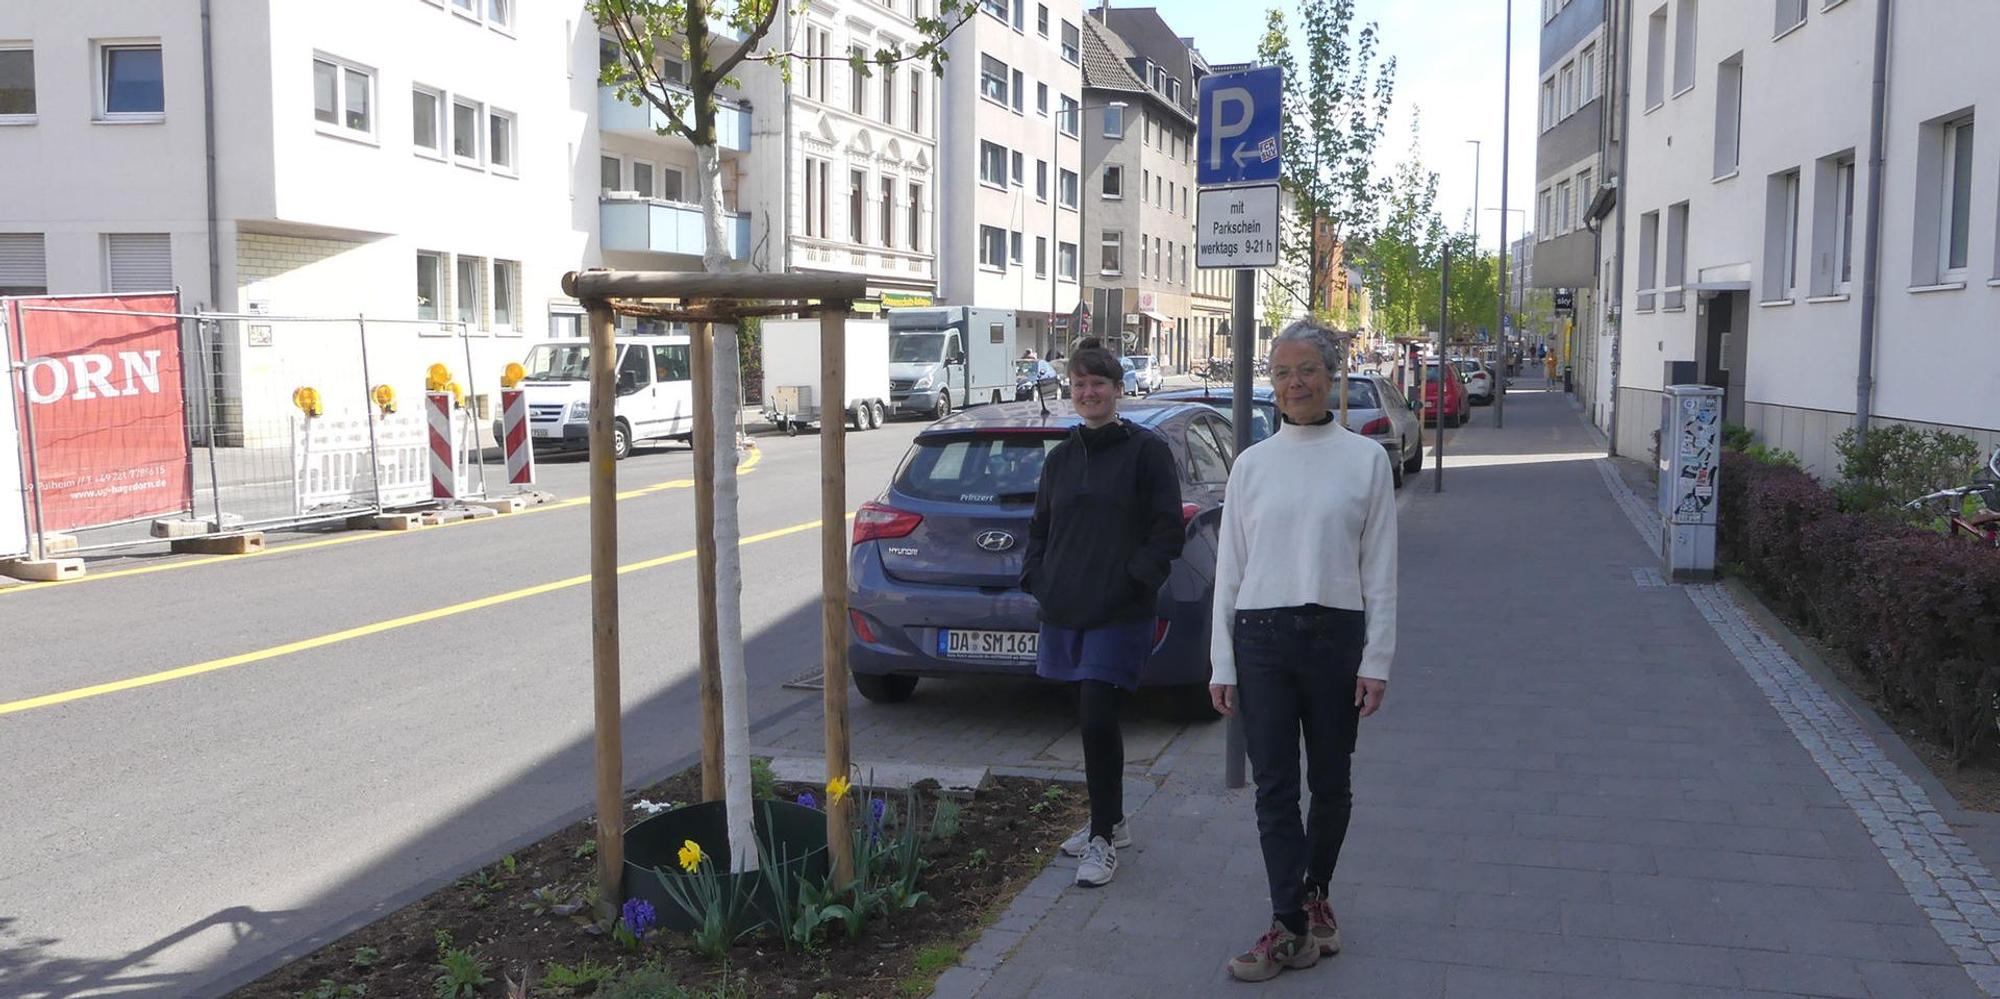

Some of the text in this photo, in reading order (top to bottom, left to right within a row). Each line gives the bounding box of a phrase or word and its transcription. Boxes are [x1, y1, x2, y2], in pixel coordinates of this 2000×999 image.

[1210, 87, 1254, 170] P
[1230, 201, 1245, 214] mit
[1213, 219, 1261, 235] Parkschein
[1201, 239, 1272, 257] werktags 9-21 h
[1557, 297, 1571, 307] sky
[888, 547, 918, 556] HYUNDAI
[949, 632, 969, 651] DA
[982, 633, 1004, 652] SM
